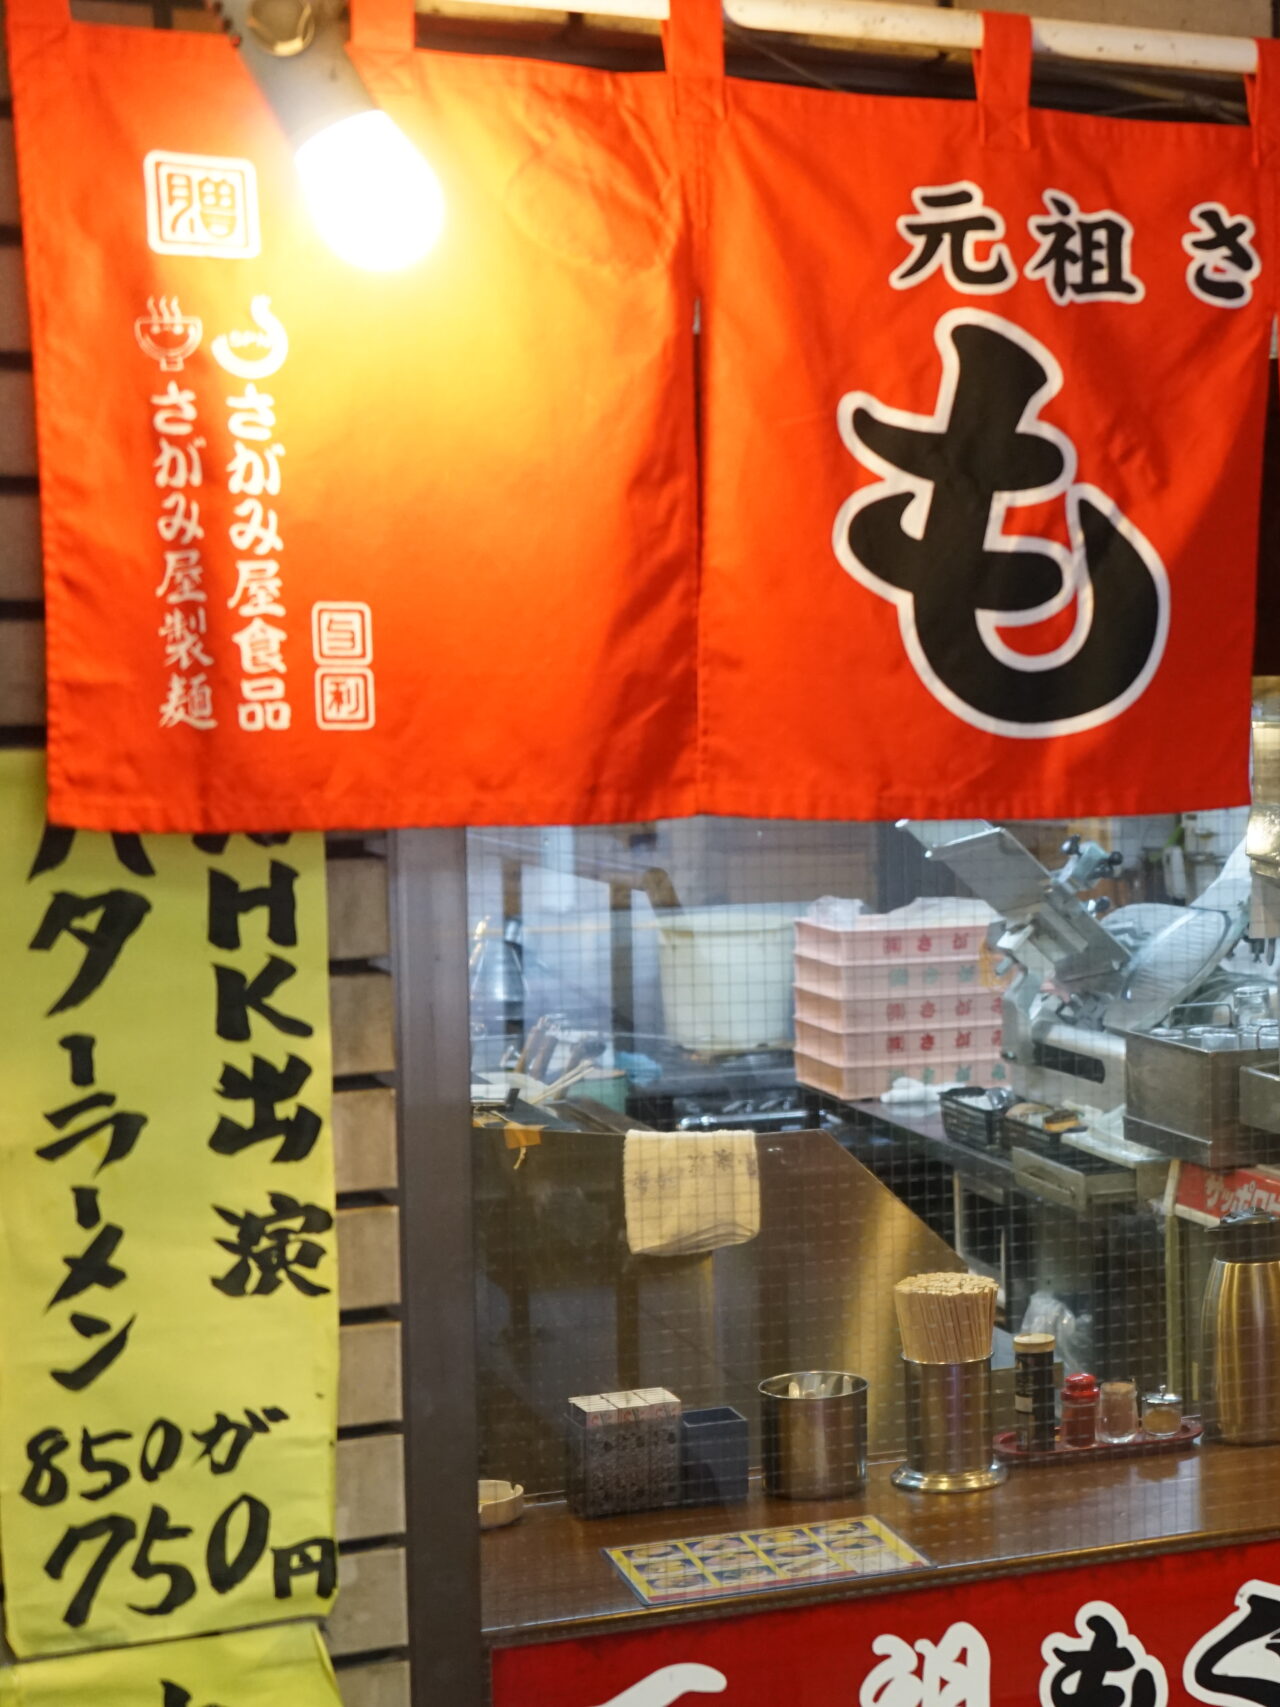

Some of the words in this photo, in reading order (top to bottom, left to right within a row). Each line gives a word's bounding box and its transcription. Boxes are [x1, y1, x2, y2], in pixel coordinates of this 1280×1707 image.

[150, 381, 218, 731] さがみ屋製麺
[225, 383, 292, 731] さがみ屋食品
[191, 831, 335, 1297] HK出演
[44, 1494, 337, 1628] 750円
